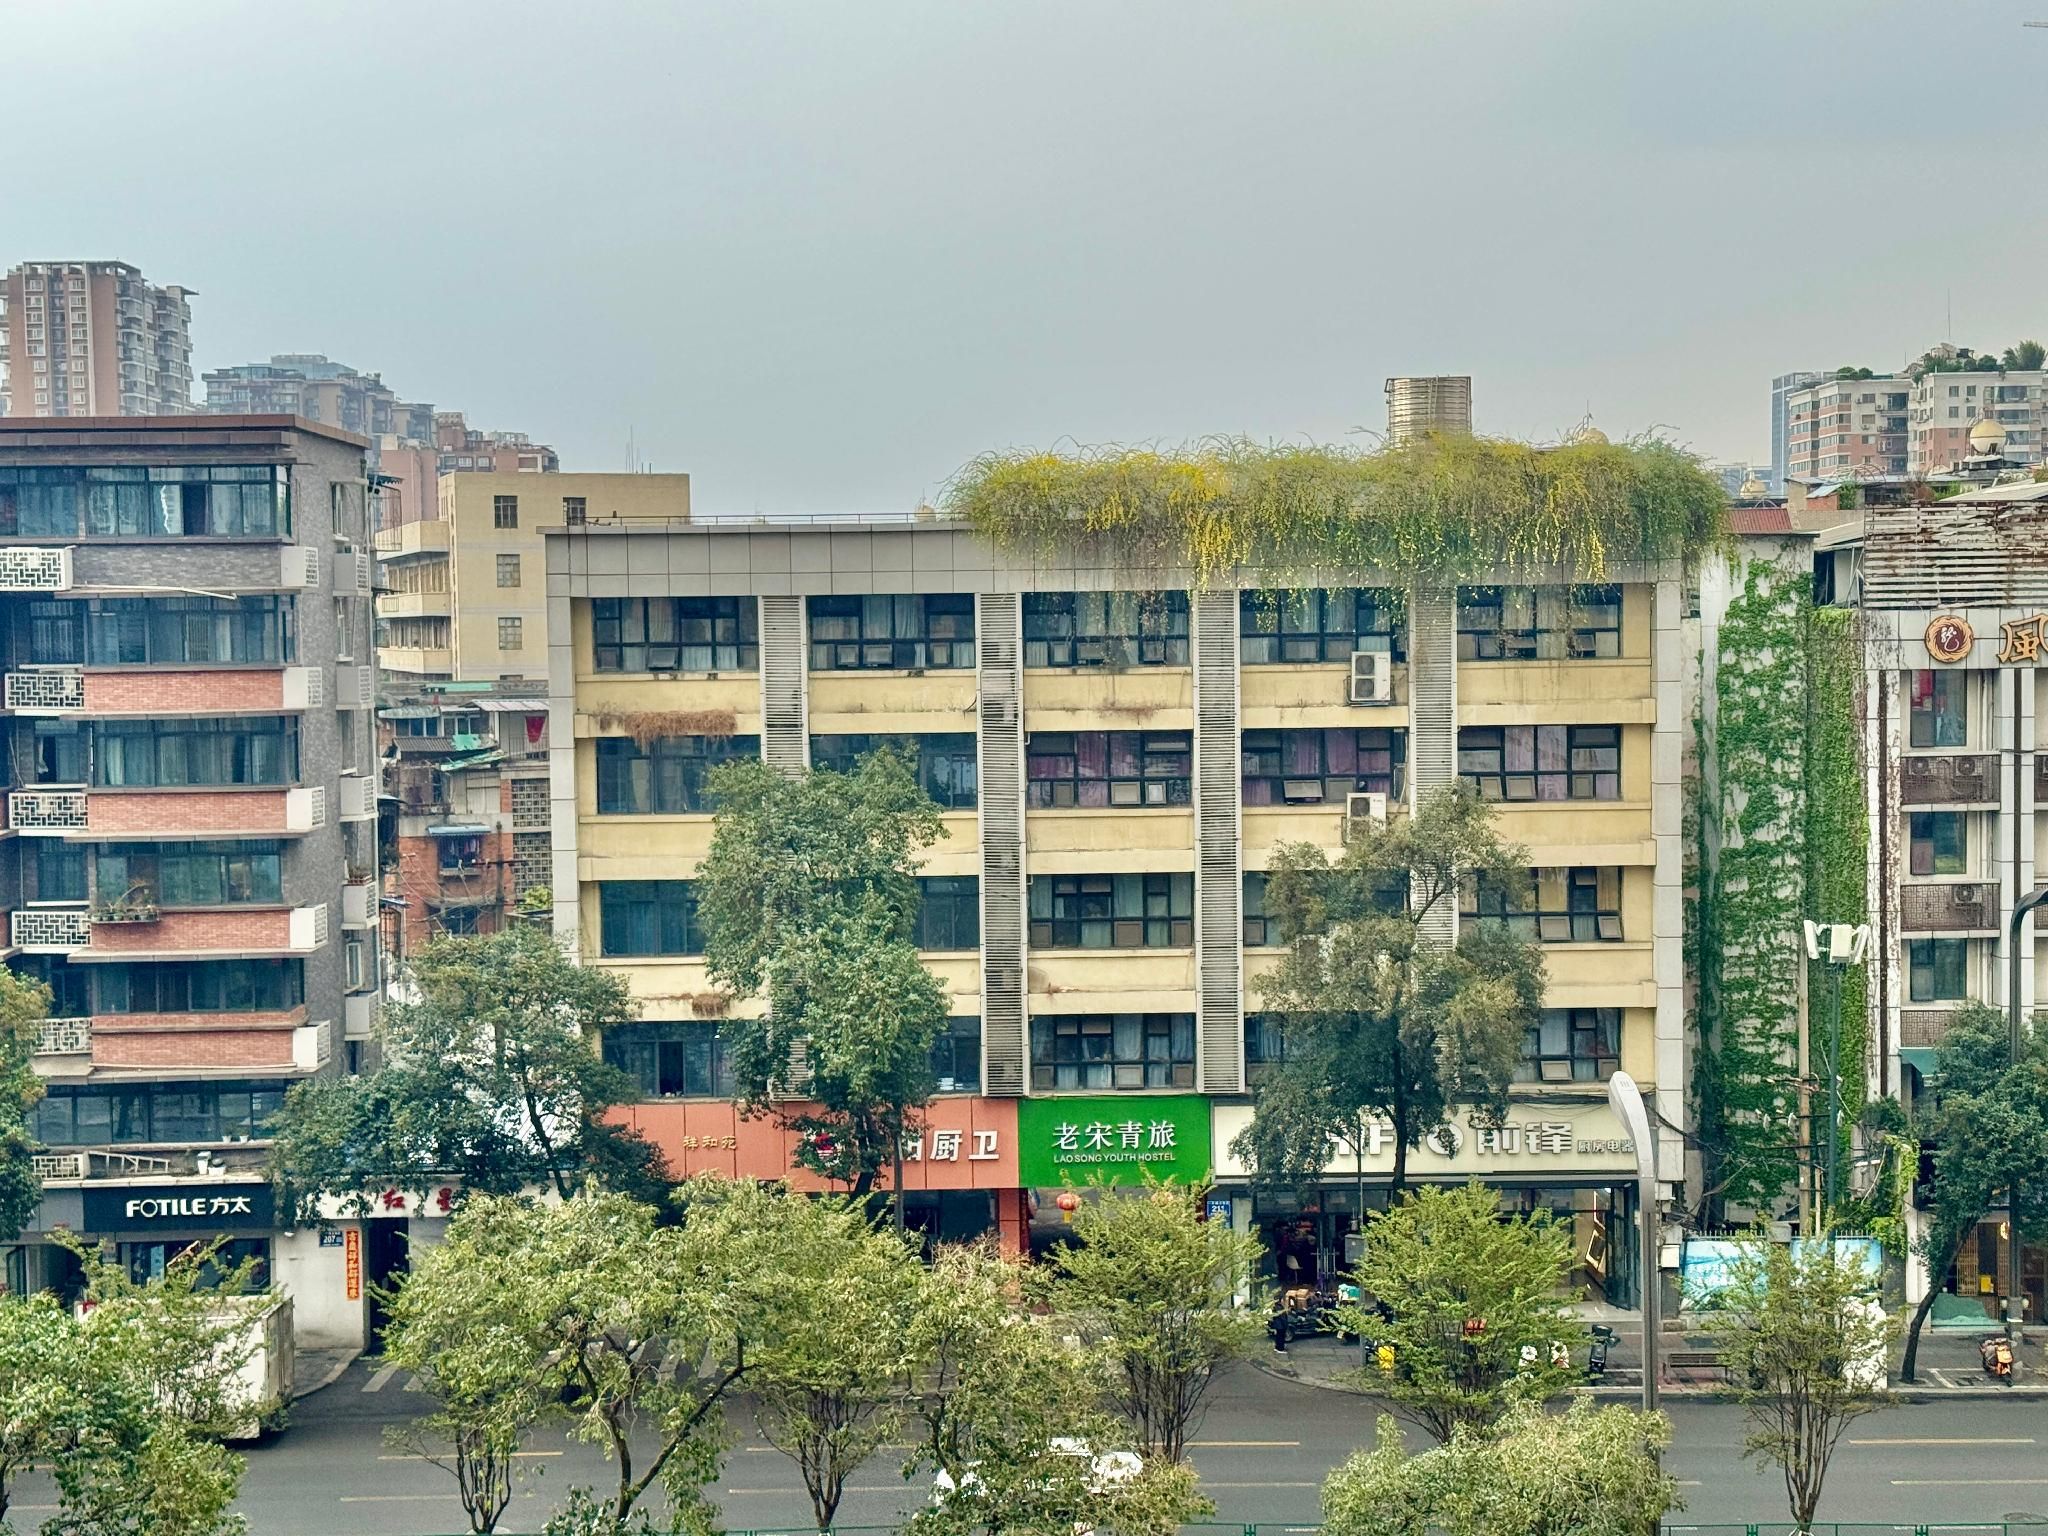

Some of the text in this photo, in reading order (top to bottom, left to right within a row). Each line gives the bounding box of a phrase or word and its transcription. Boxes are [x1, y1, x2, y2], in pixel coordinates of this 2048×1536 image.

[1051, 1119, 1177, 1150] 老宋青旅
[1477, 1121, 1573, 1155] 前锋
[1577, 1139, 1635, 1153] 厨房电器
[1102, 1152, 1136, 1162] YOUTH
[1138, 1151, 1177, 1162] HOSTEL
[126, 1196, 251, 1218] FOTILE 方太
[323, 1235, 336, 1243] 207
